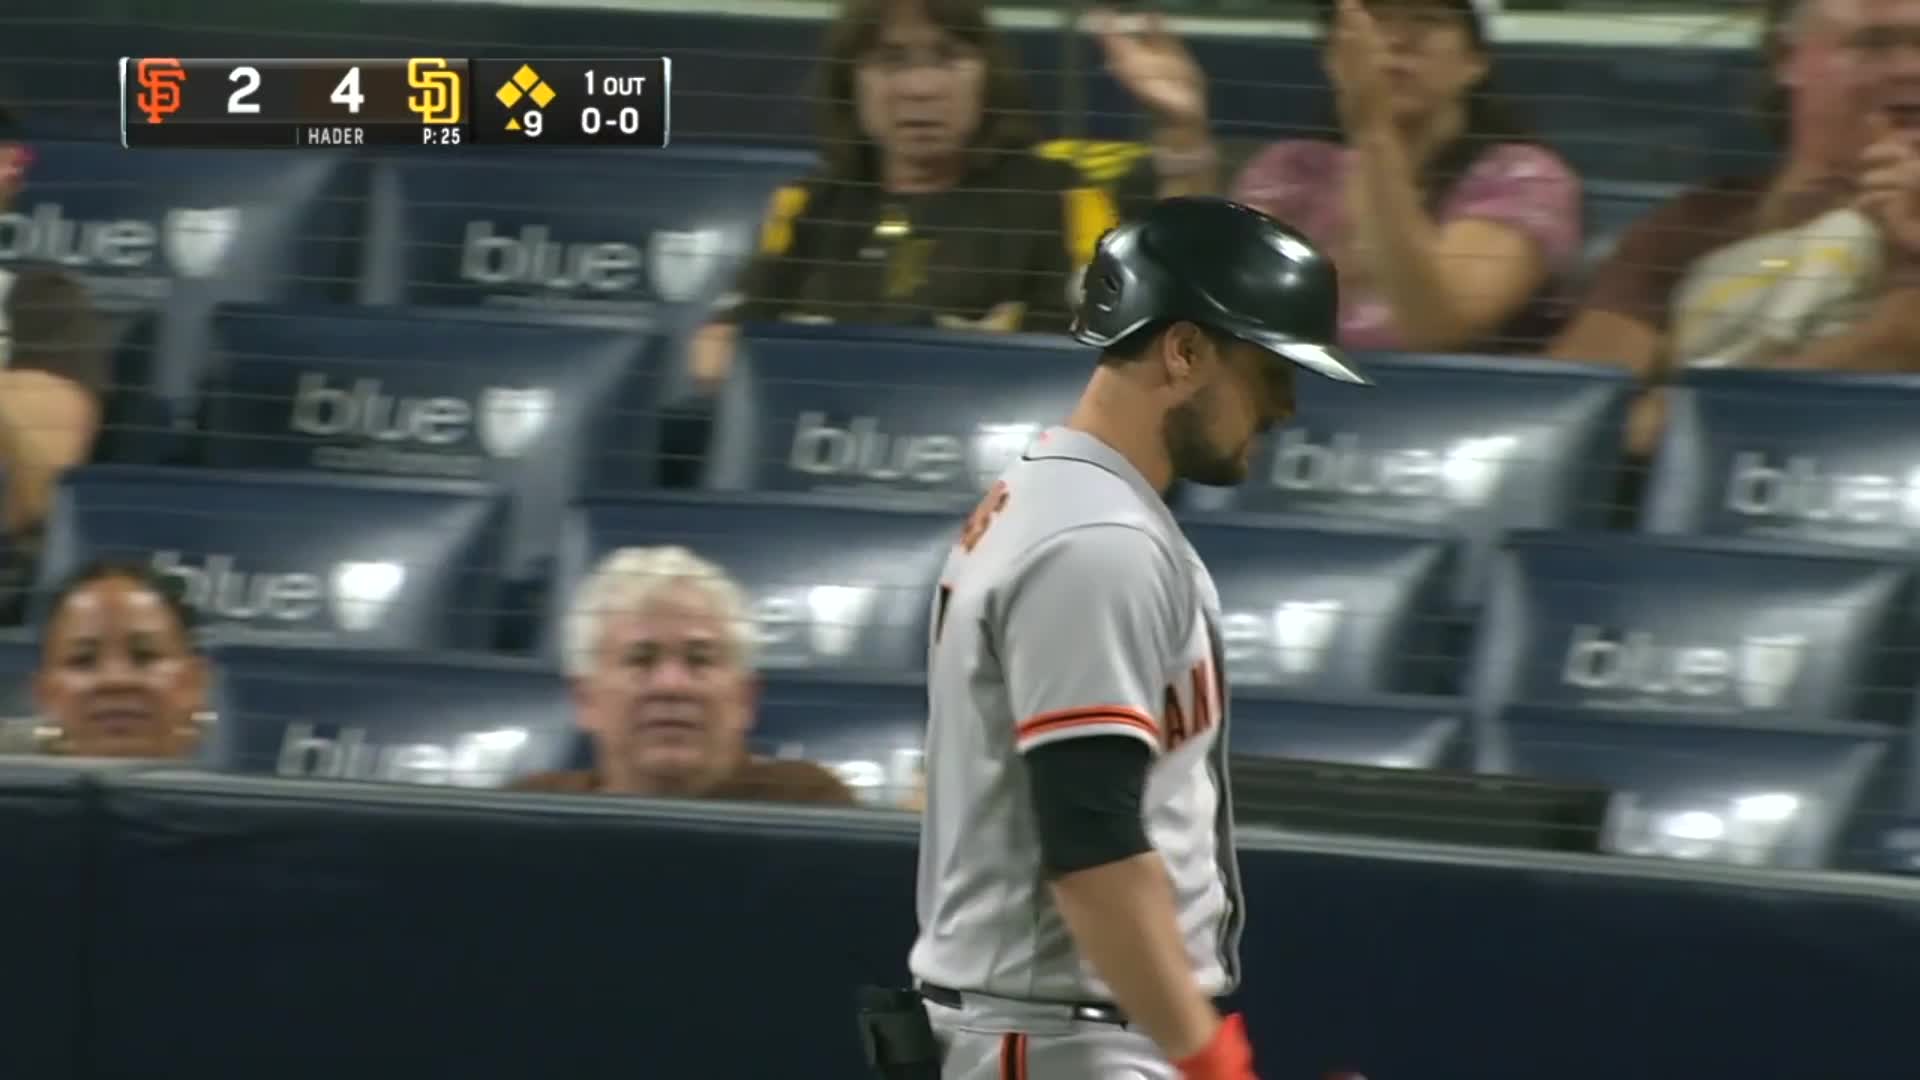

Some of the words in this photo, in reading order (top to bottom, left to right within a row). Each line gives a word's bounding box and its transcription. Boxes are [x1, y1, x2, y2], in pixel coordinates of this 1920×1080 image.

[461, 222, 642, 292] blue
[293, 373, 470, 443] blue
[791, 413, 962, 481] blue
[1274, 428, 1440, 496] blue
[1729, 452, 1894, 520] blue
[1563, 625, 1730, 695] blue
